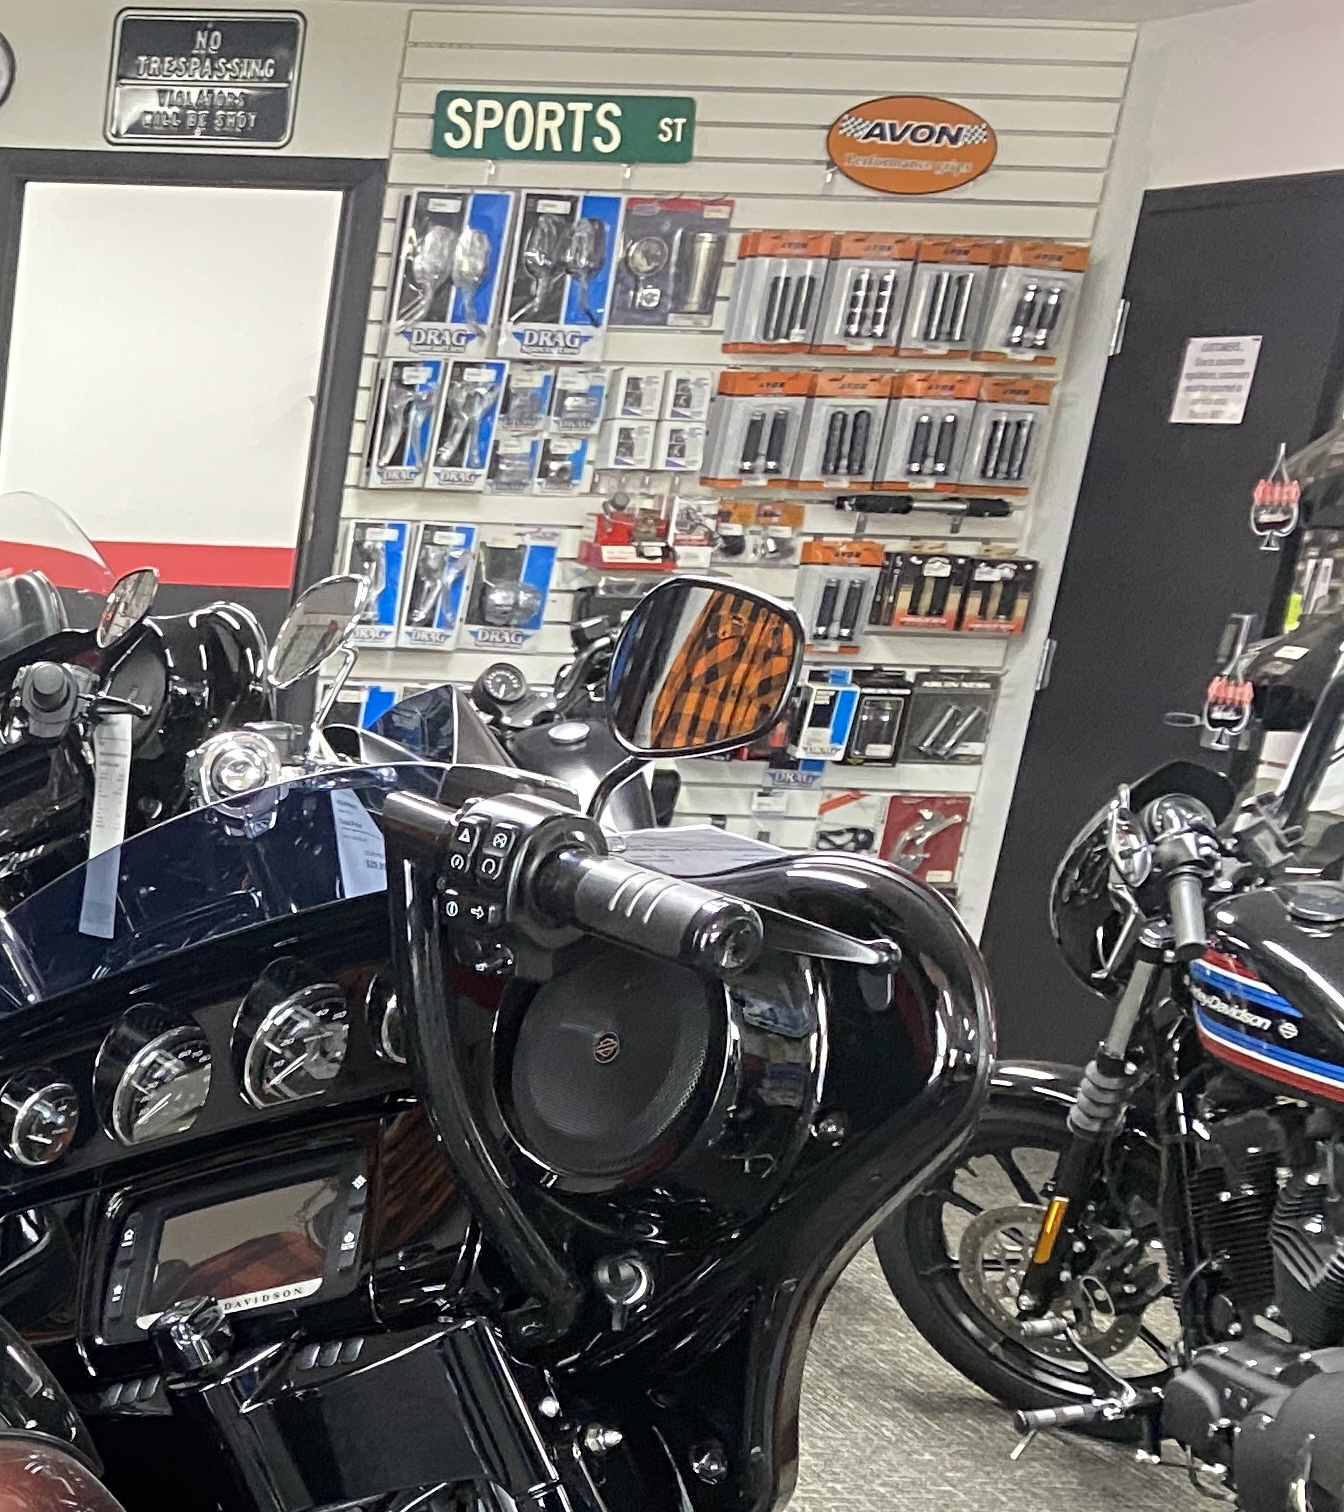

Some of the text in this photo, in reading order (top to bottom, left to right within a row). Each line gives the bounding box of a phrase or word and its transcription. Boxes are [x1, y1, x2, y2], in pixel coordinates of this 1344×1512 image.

[194, 30, 223, 51] NO
[135, 56, 275, 79] TRESPASSING
[156, 89, 246, 107] VIOLATORS
[186, 111, 208, 128] BE
[215, 111, 257, 129] SHOT
[443, 99, 687, 153] SPORTS ST
[861, 121, 965, 146] AVON
[412, 329, 466, 346] DRAG
[524, 329, 580, 347] DRAG
[477, 629, 523, 644] DRAG
[223, 1286, 304, 1311] DAVIDSON
